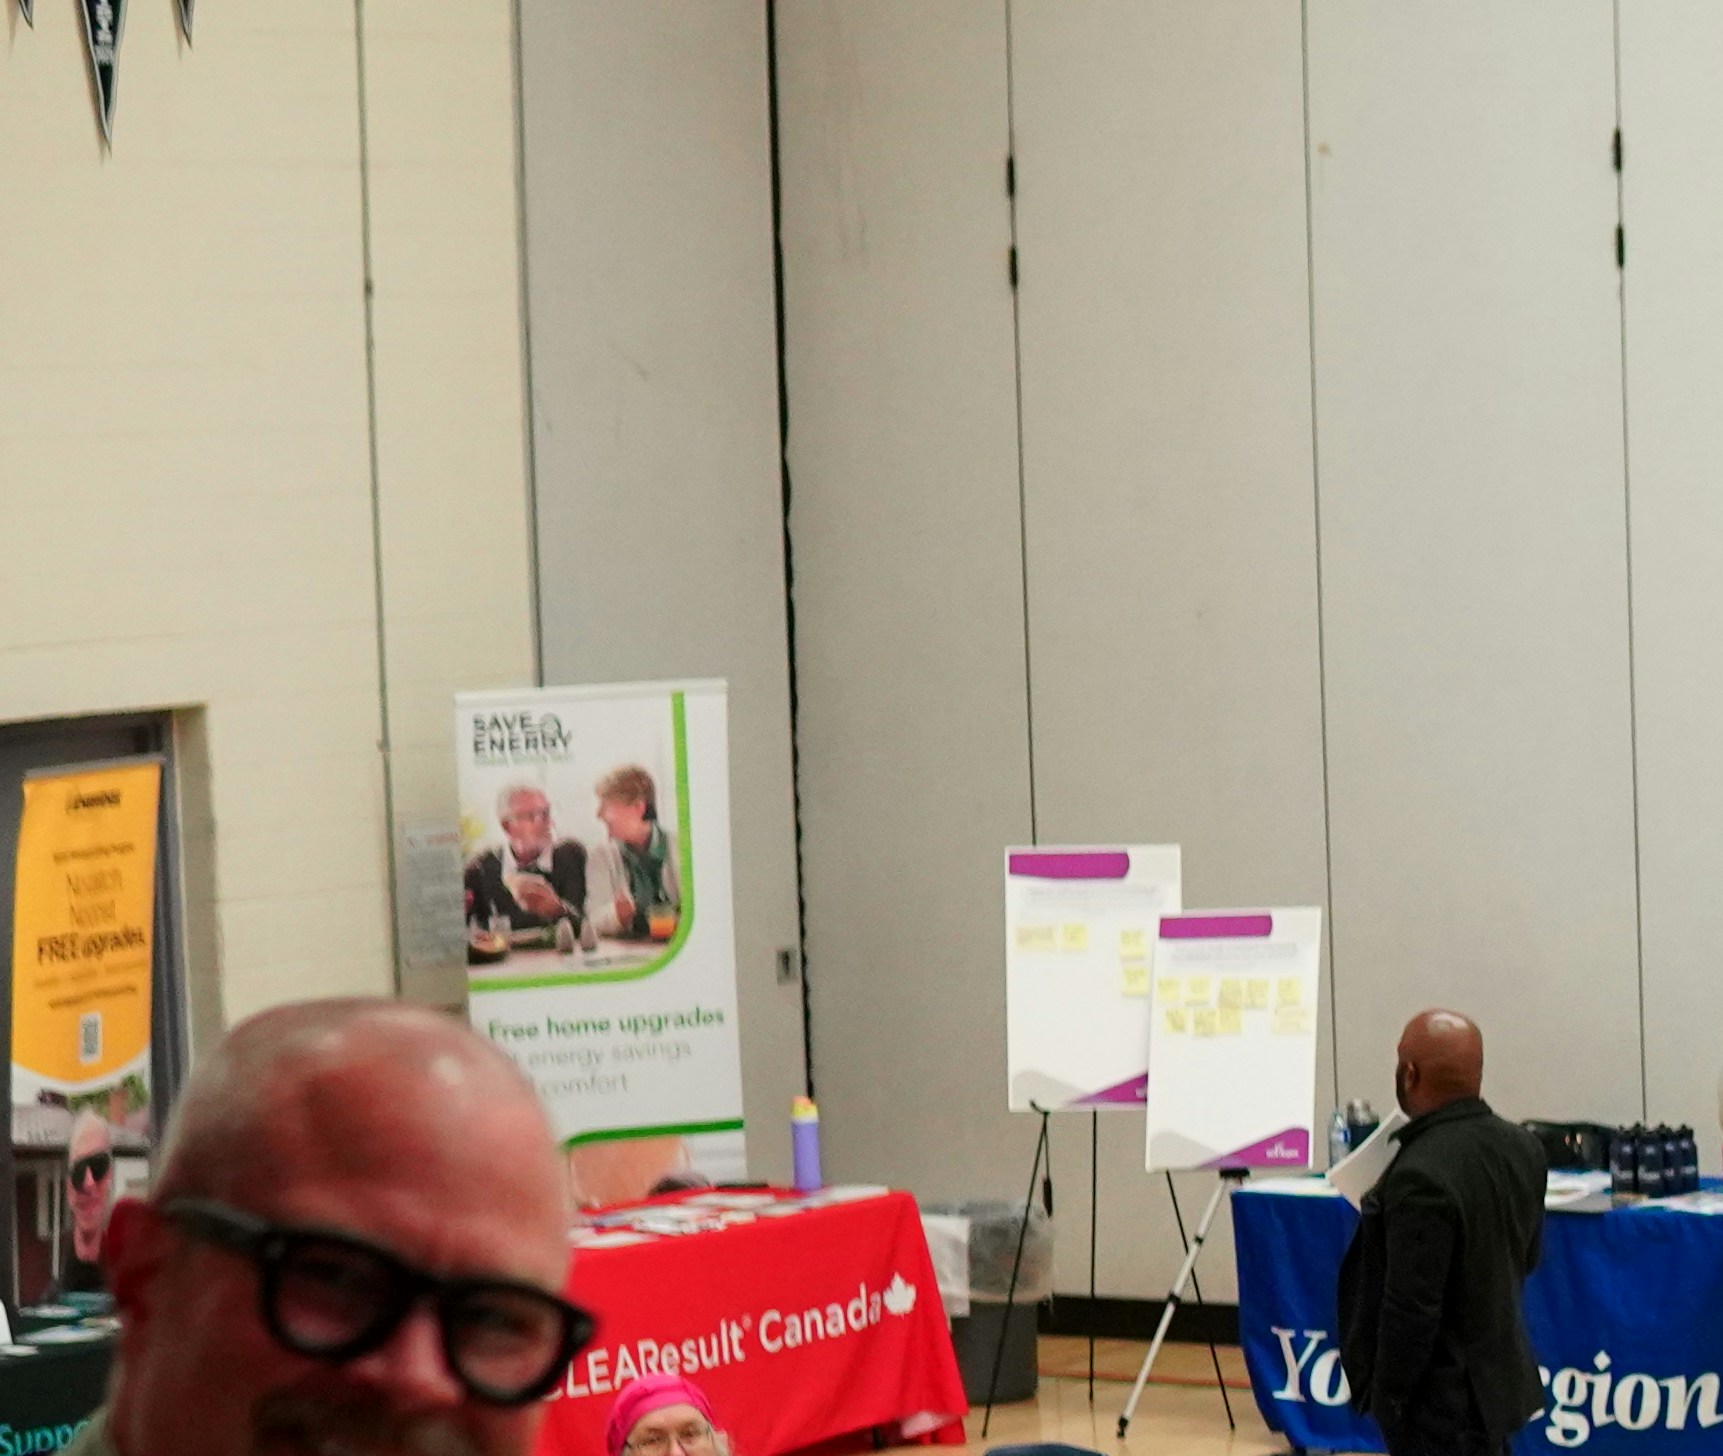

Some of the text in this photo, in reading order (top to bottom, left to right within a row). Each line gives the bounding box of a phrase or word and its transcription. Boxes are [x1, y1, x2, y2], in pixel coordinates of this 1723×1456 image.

[488, 1006, 725, 1041] Free home upgrades
[758, 1281, 884, 1355] Canada
[1269, 1325, 1351, 1408] Yo
